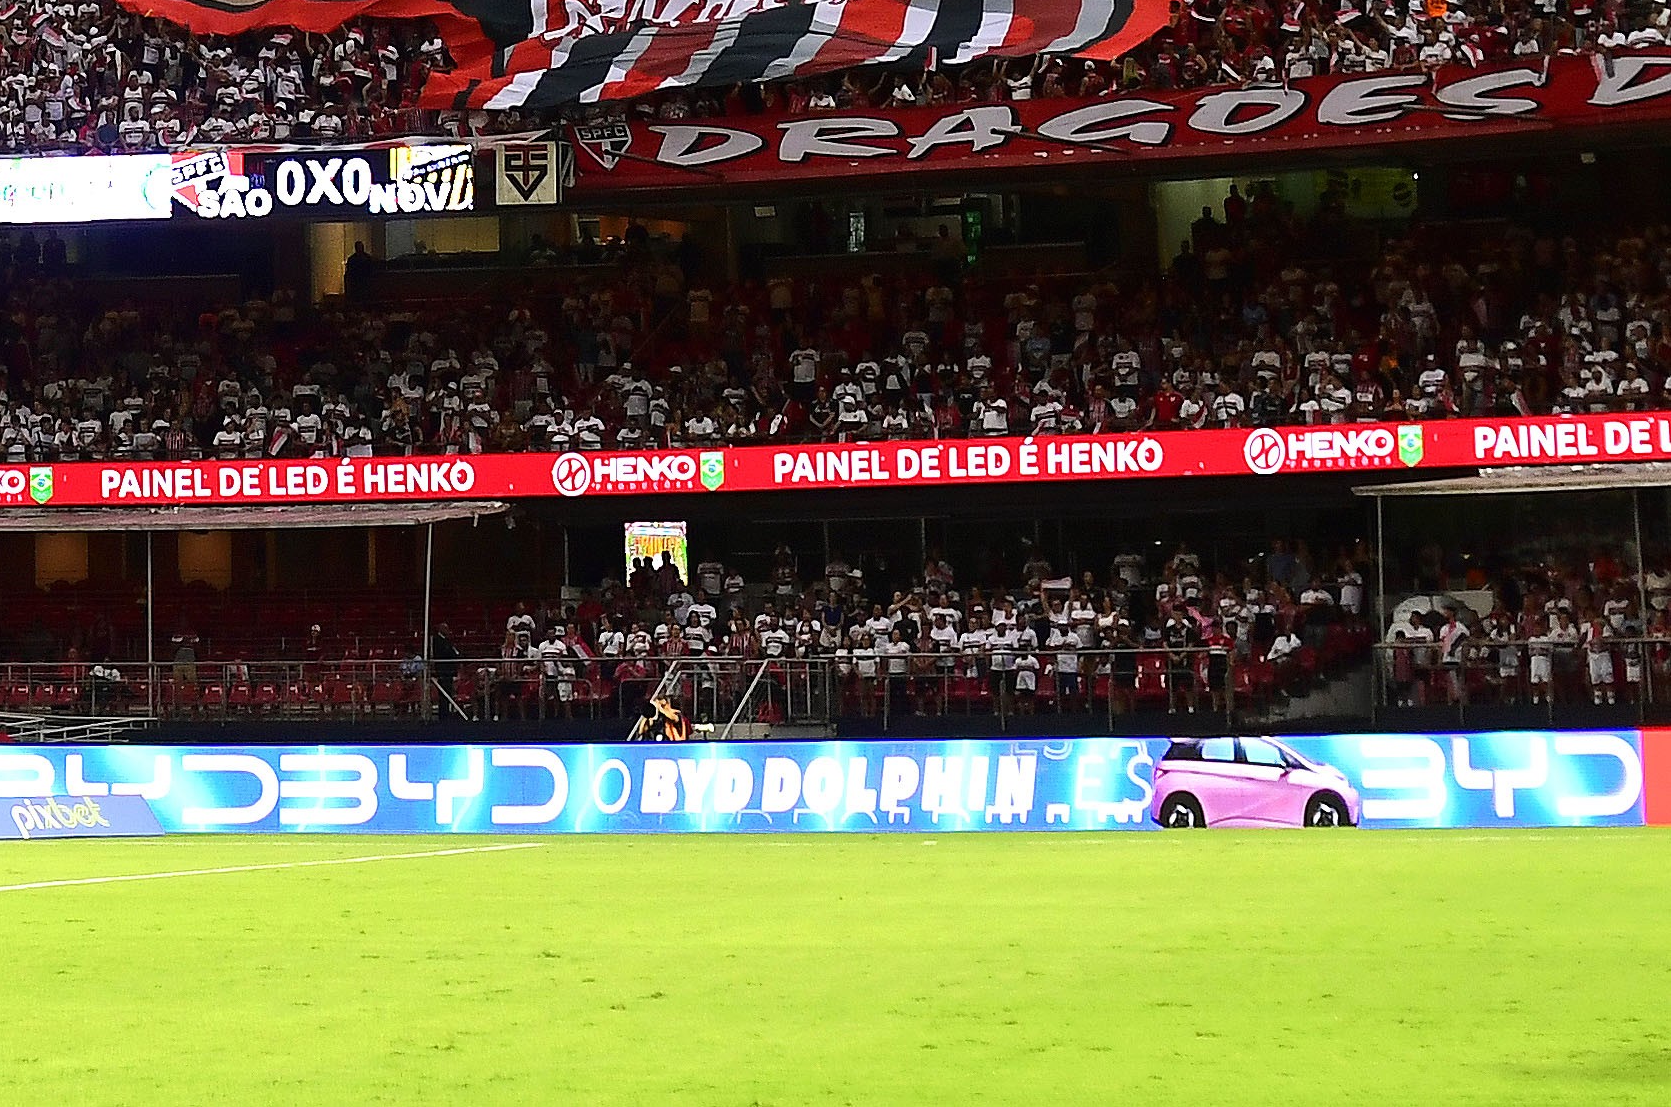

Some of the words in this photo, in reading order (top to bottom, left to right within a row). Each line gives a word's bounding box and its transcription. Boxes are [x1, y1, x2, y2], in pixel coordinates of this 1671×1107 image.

[580, 125, 626, 140] SPFC
[649, 66, 1545, 167] DRAGÕES
[773, 450, 889, 484] PAINEL
[897, 446, 941, 479] DE
[948, 445, 1011, 477] LED
[1019, 436, 1039, 476] É
[1047, 438, 1164, 474] HENKO
[1288, 429, 1394, 459] HENKO
[1474, 423, 1598, 459] PAINEL
[1604, 420, 1654, 455] DE
[100, 466, 212, 498] PAINEL
[218, 464, 263, 497] DE
[269, 465, 329, 497] LED
[336, 457, 356, 495] É
[363, 460, 475, 494] HENKO
[593, 455, 696, 482] HENKO
[279, 749, 569, 825] BYD
[639, 758, 754, 814] BYD
[761, 756, 1038, 814] DOLPHIN
[1360, 735, 1643, 819] BYD
[9, 796, 110, 840] pixbet
